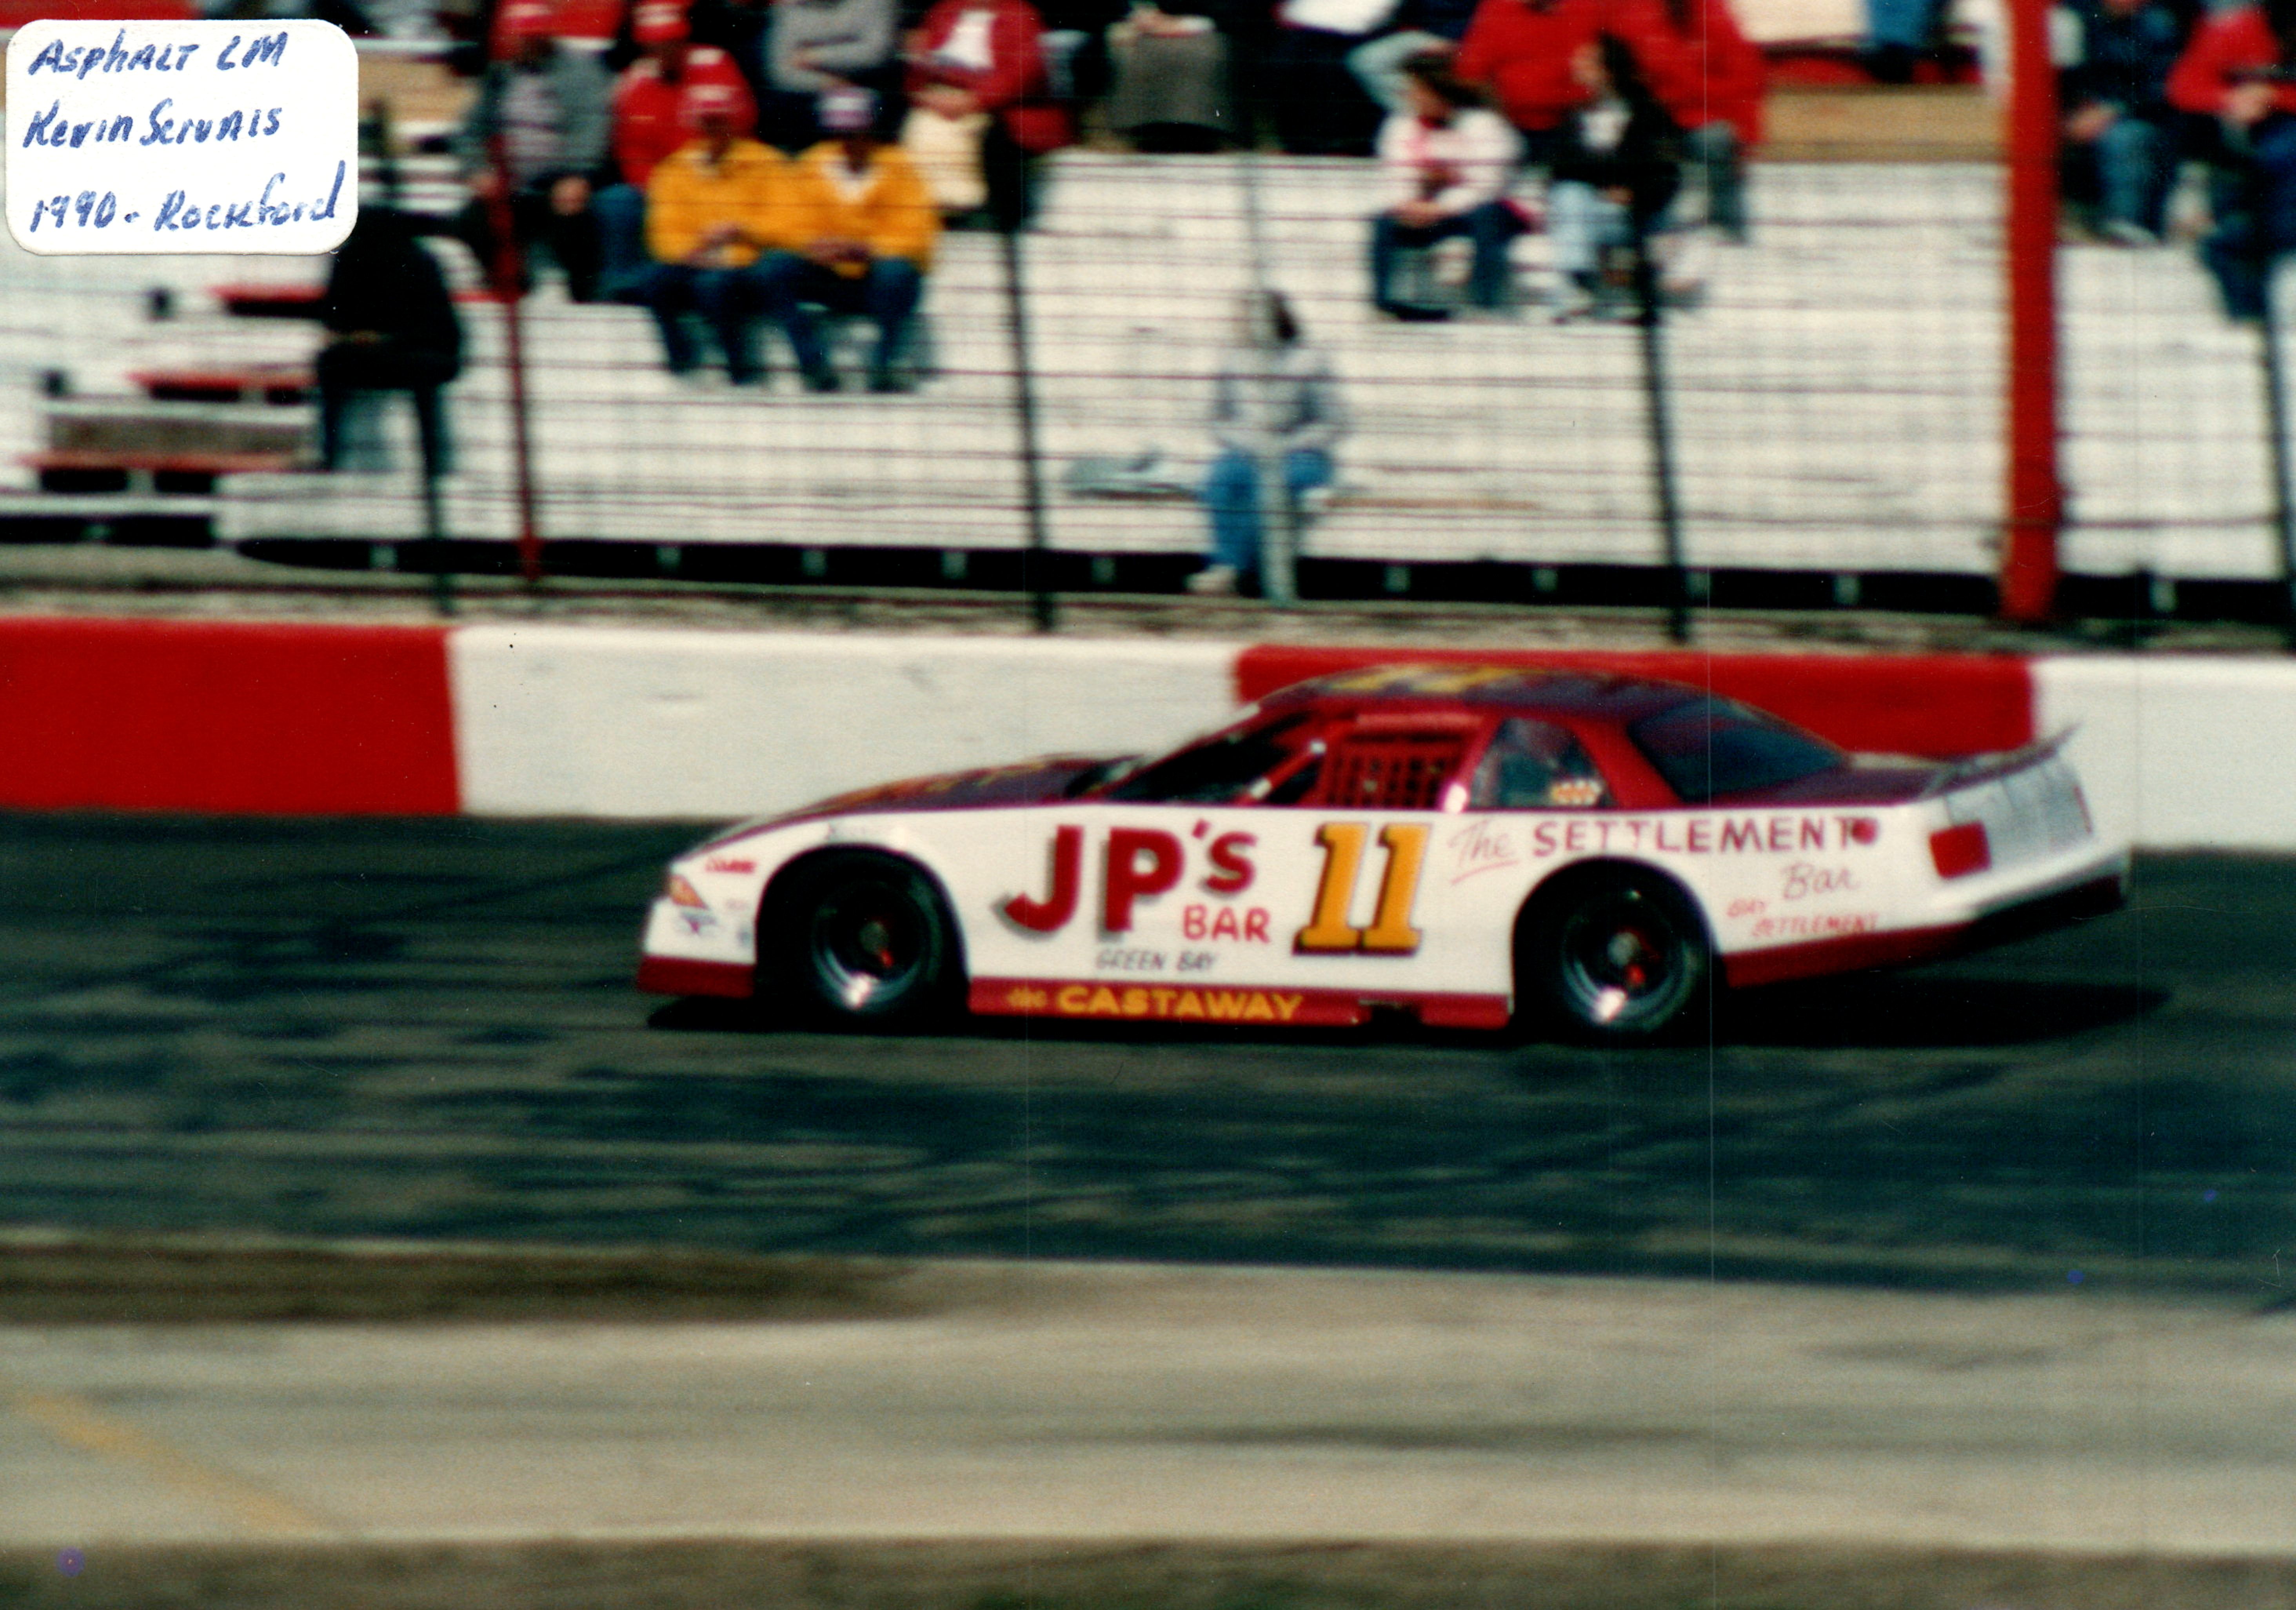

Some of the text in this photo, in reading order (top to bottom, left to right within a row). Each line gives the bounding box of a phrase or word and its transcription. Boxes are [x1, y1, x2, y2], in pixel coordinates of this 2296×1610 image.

[1448, 816, 1854, 866] The SETTLEMENT
[1292, 821, 1433, 957] 11
[1782, 861, 1862, 900] Bar
[1183, 904, 1271, 943] BAR
[1096, 949, 1218, 971] GREEN BAY
[1056, 984, 1303, 1021] CASTAWAY
